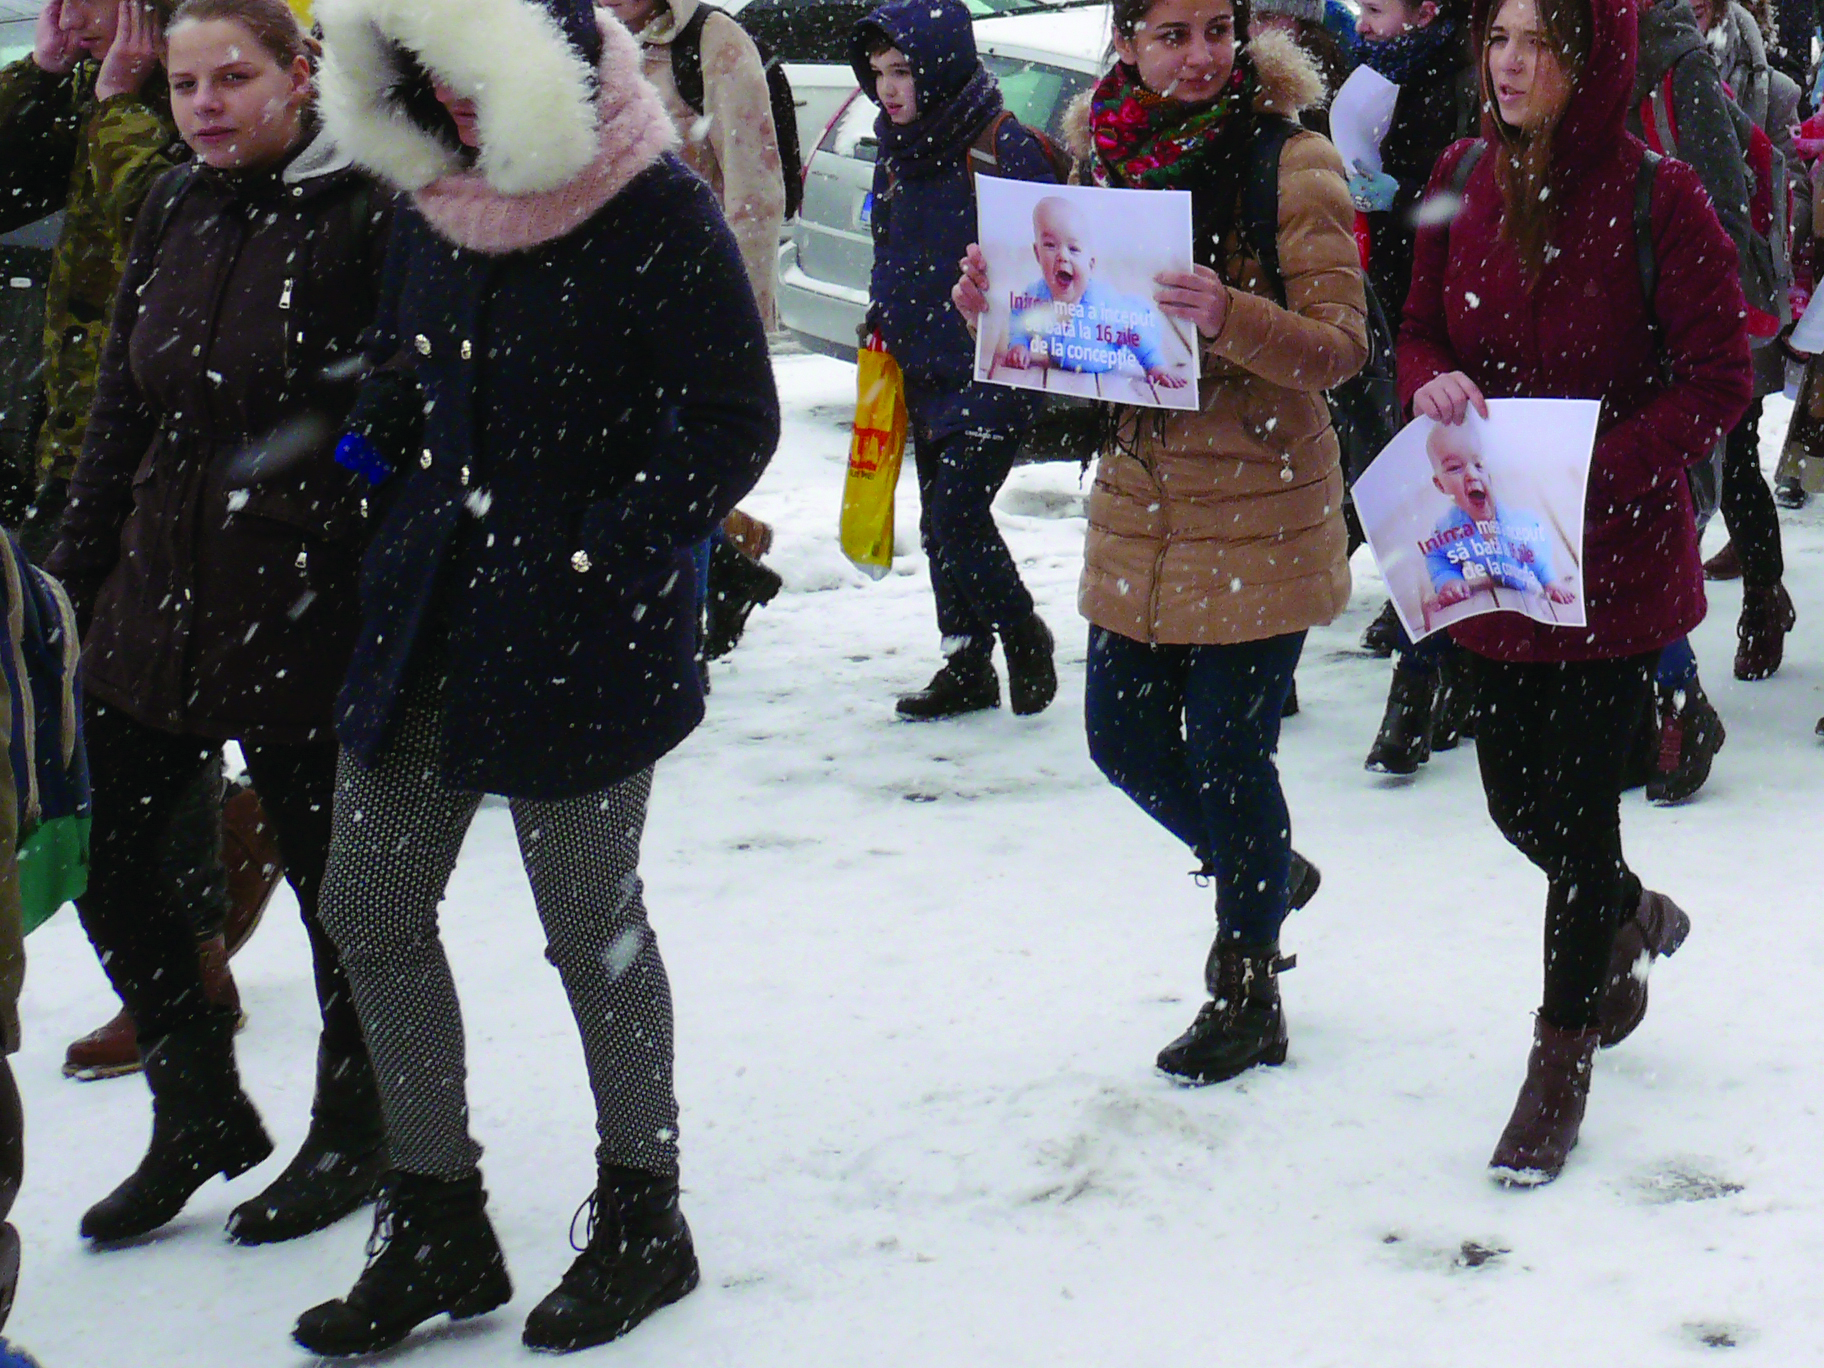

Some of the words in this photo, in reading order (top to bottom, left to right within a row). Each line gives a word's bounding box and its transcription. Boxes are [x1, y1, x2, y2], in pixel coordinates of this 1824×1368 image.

[1054, 301, 1084, 319] mea
[1088, 306, 1097, 319] a
[1079, 321, 1092, 339] la
[1095, 323, 1113, 343] 16
[1116, 326, 1141, 347] zile
[1030, 336, 1048, 354] de
[1051, 336, 1064, 356] la
[1417, 522, 1475, 555] Inima
[1447, 541, 1471, 564] să
[1462, 561, 1487, 580] de
